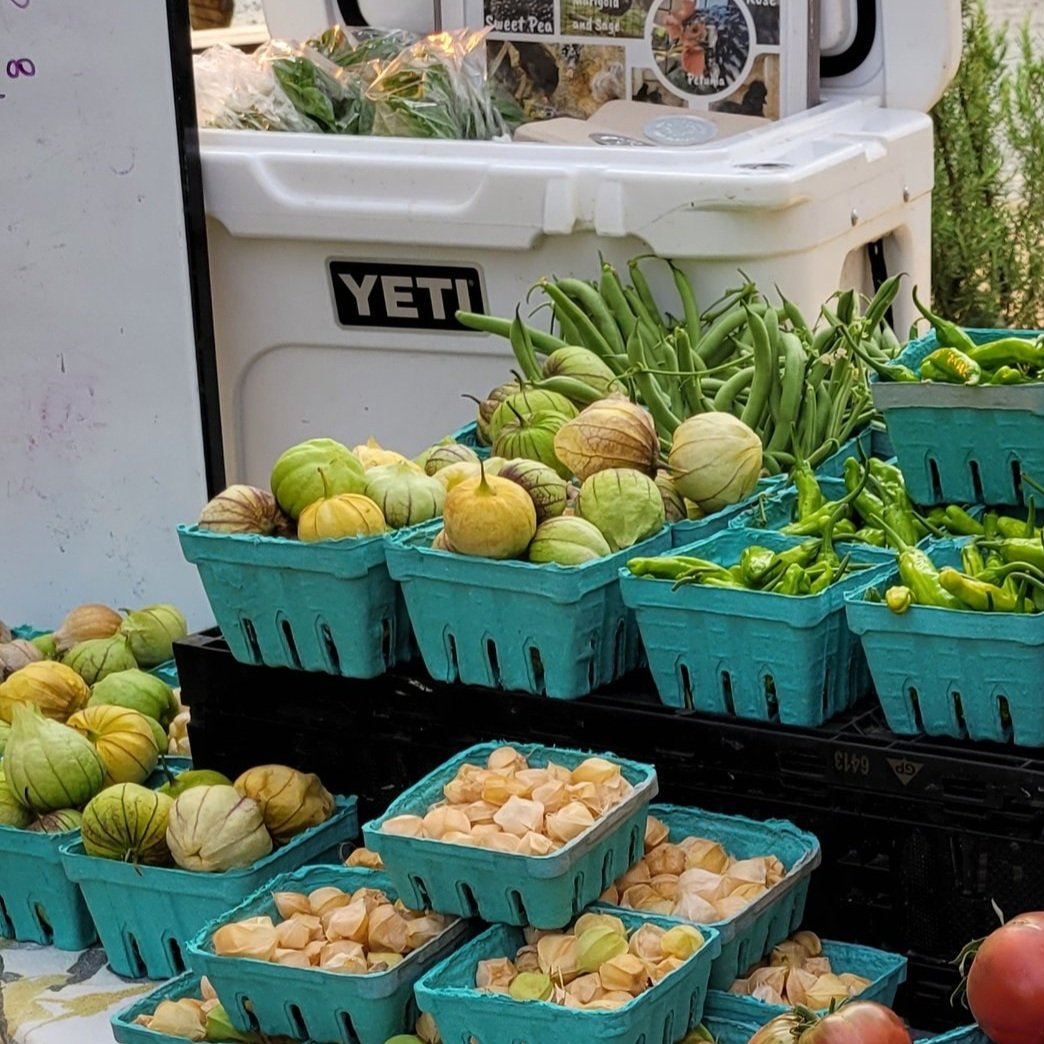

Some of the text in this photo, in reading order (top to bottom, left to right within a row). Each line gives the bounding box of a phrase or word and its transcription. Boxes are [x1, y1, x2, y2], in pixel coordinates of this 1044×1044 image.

[485, 15, 554, 33] Sweet Pea
[572, 16, 621, 37] and Sage
[337, 273, 473, 320] YETI
[834, 750, 870, 775] 6413
